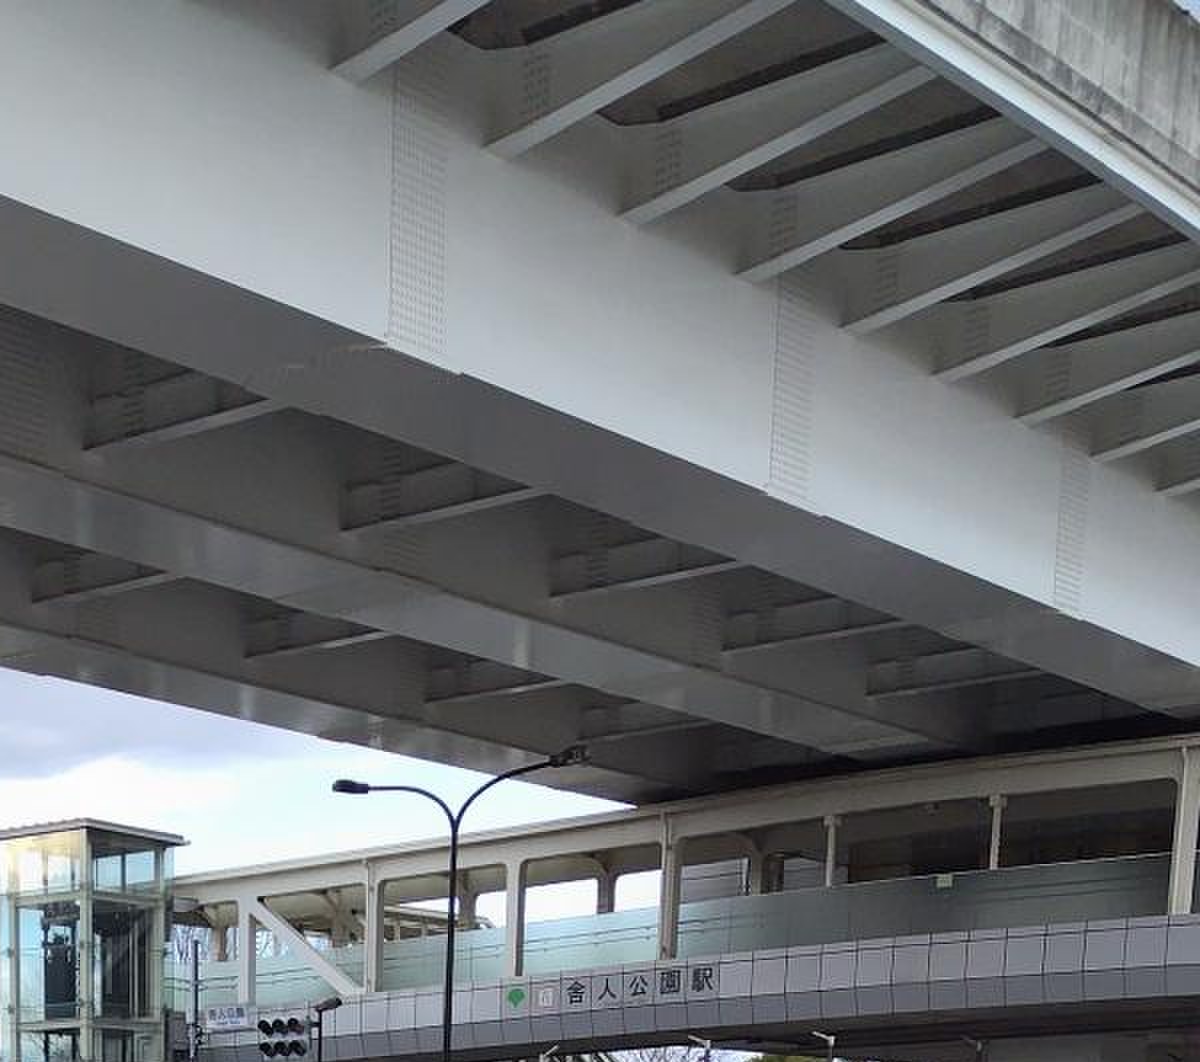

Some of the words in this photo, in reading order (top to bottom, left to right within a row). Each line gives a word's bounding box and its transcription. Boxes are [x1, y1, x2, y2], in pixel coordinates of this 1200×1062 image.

[567, 967, 713, 1005] 舎人公園駅
